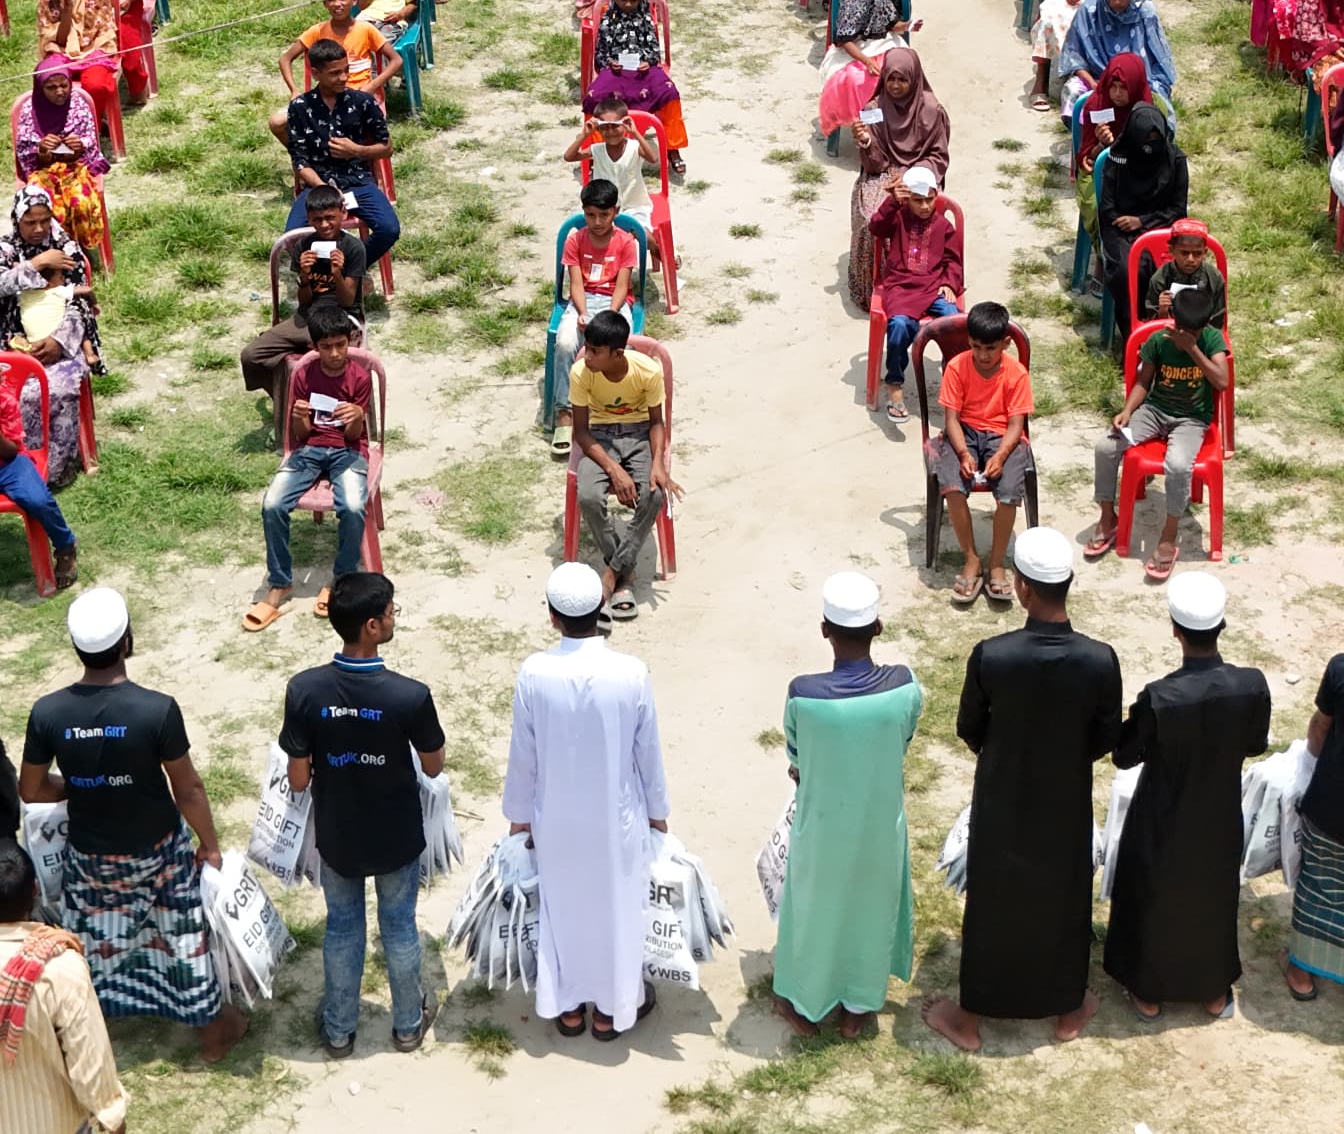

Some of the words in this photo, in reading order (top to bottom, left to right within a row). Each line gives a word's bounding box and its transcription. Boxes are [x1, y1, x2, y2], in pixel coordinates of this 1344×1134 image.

[274, 813, 302, 839] GIFT
[233, 868, 257, 908] GRT
[242, 921, 262, 948] EID
[657, 966, 691, 982] WBS
